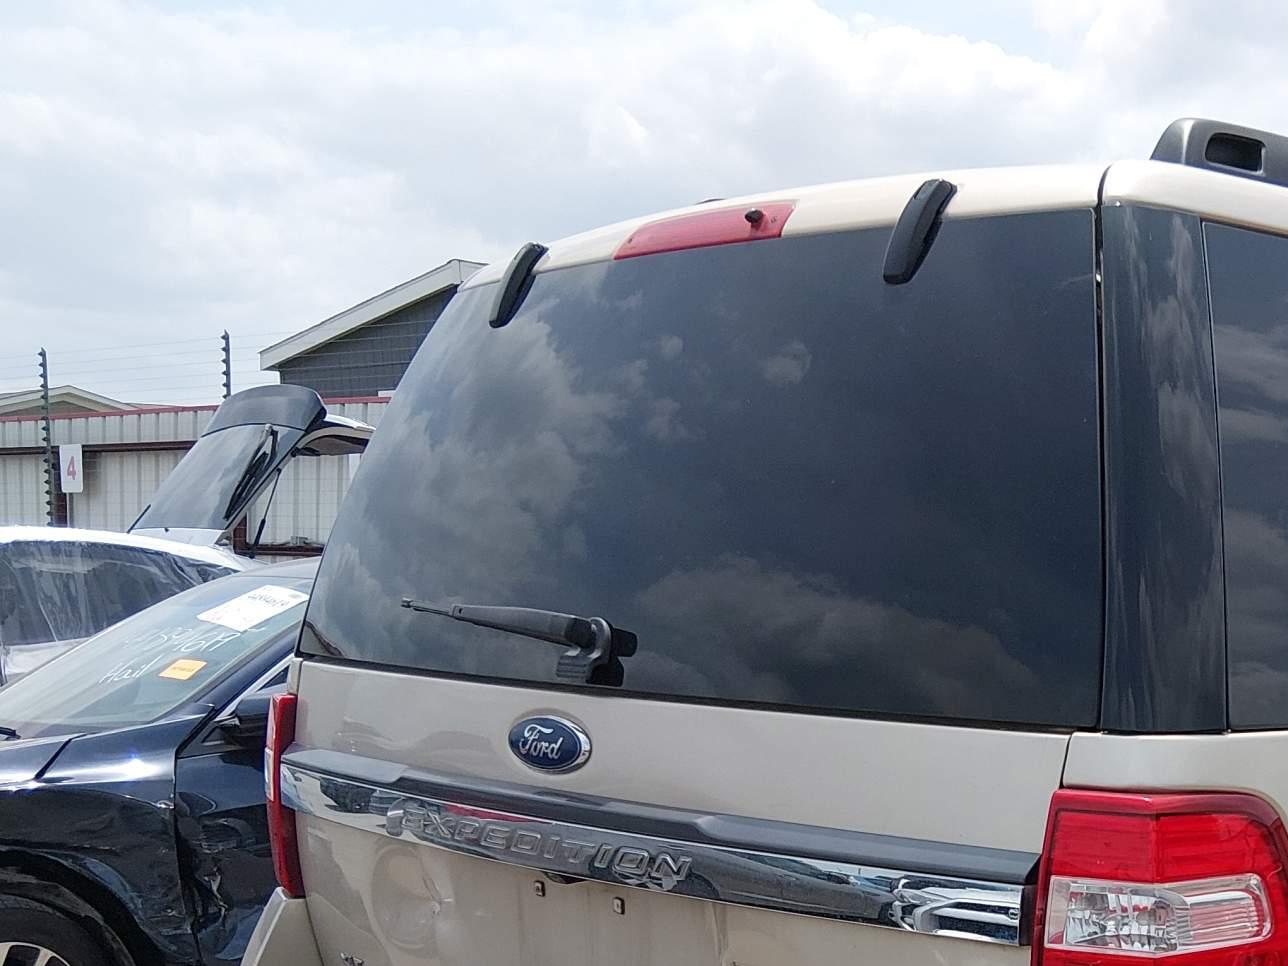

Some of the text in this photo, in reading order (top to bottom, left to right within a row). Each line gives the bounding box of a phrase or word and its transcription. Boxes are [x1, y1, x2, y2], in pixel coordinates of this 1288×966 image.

[67, 455, 77, 480] 4
[98, 655, 162, 684] Hail
[519, 723, 563, 760] Ford
[401, 804, 693, 881] EXPEDITION
